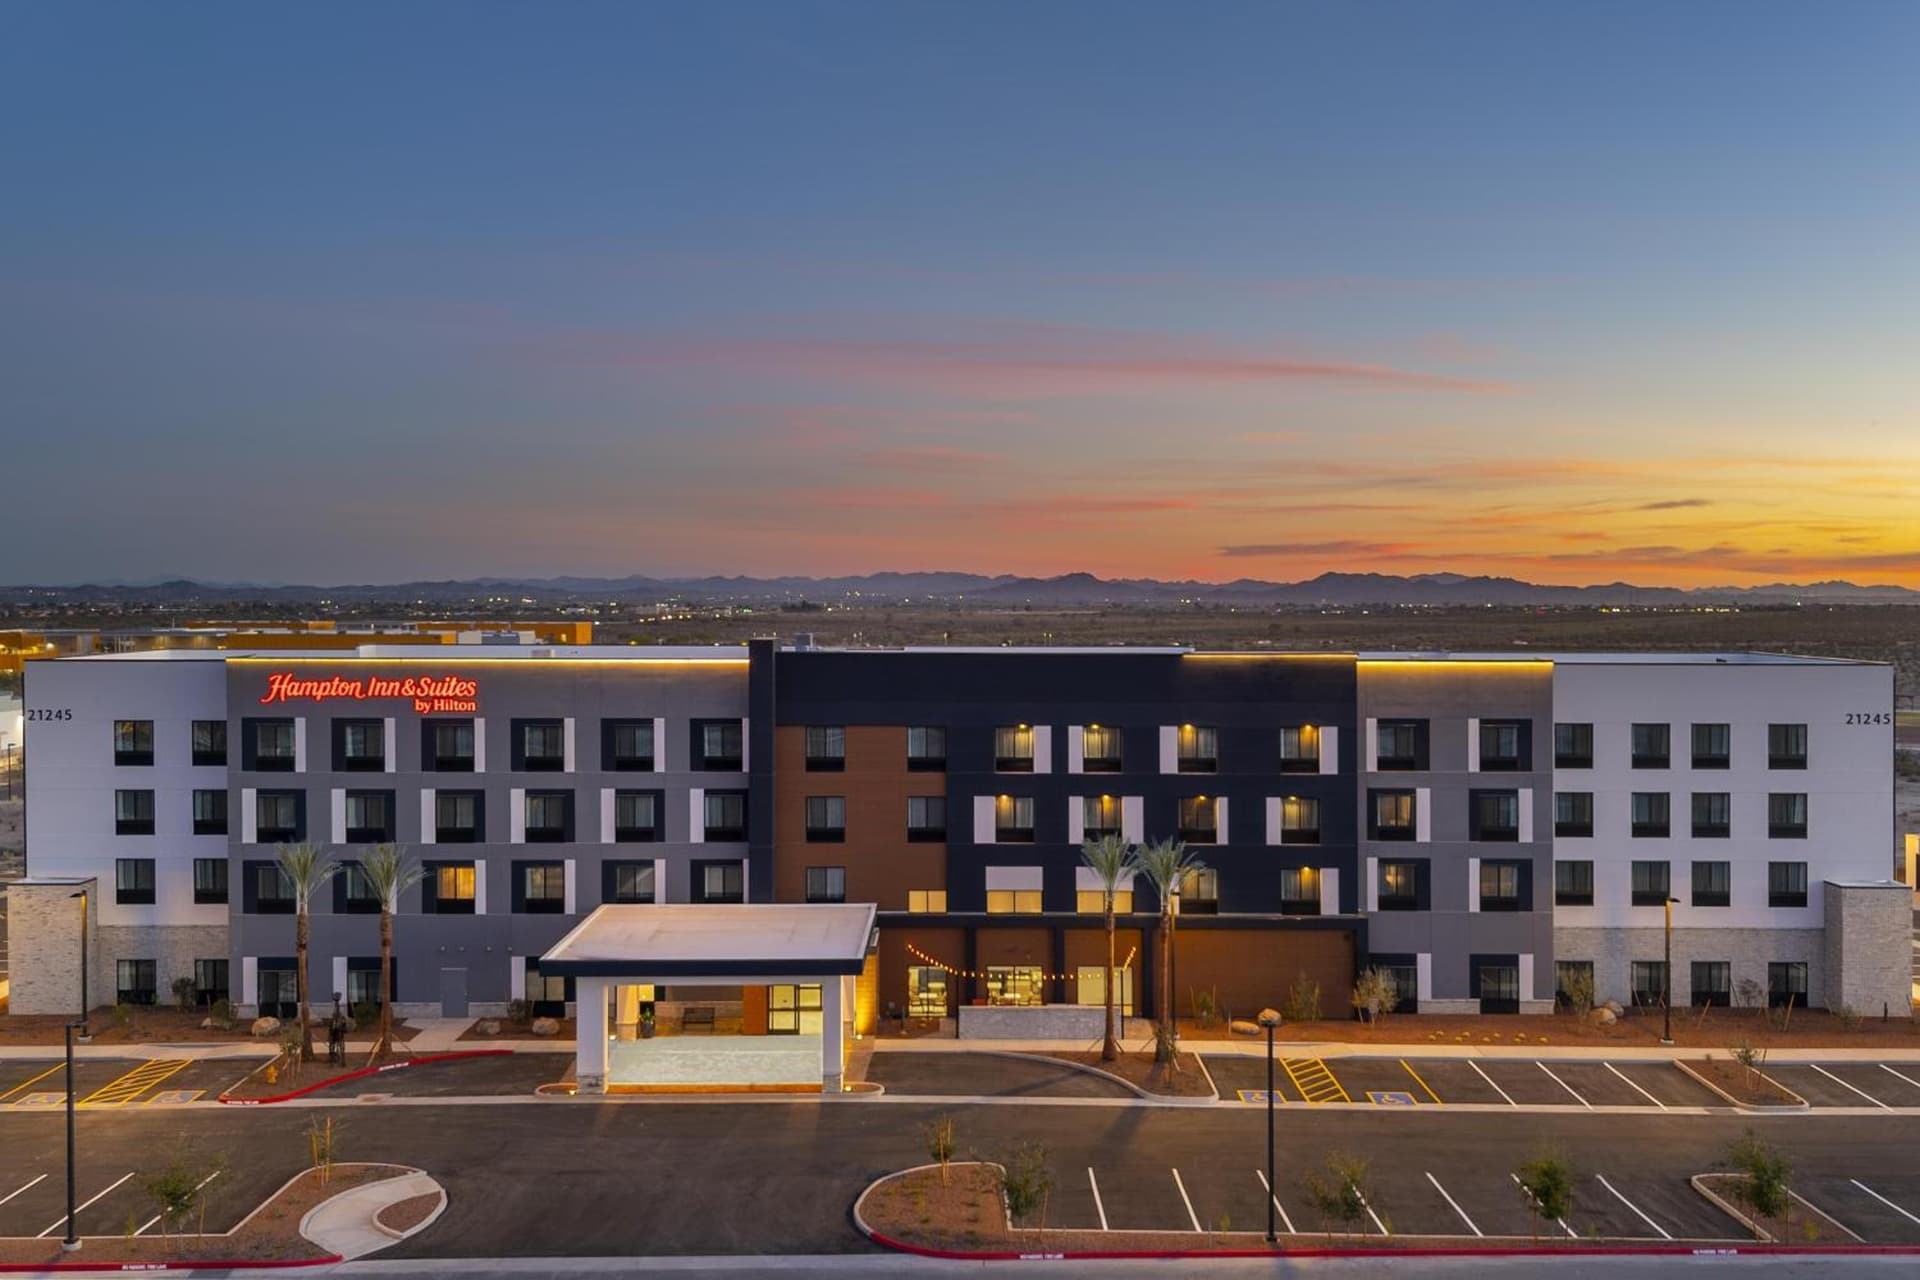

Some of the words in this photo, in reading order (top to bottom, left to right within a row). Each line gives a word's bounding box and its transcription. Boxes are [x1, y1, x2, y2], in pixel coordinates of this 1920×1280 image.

[260, 673, 366, 702] Hampton
[415, 699, 431, 714] by
[434, 699, 476, 711] Hilton
[28, 709, 72, 720] 21245
[1845, 713, 1891, 725] 21245
